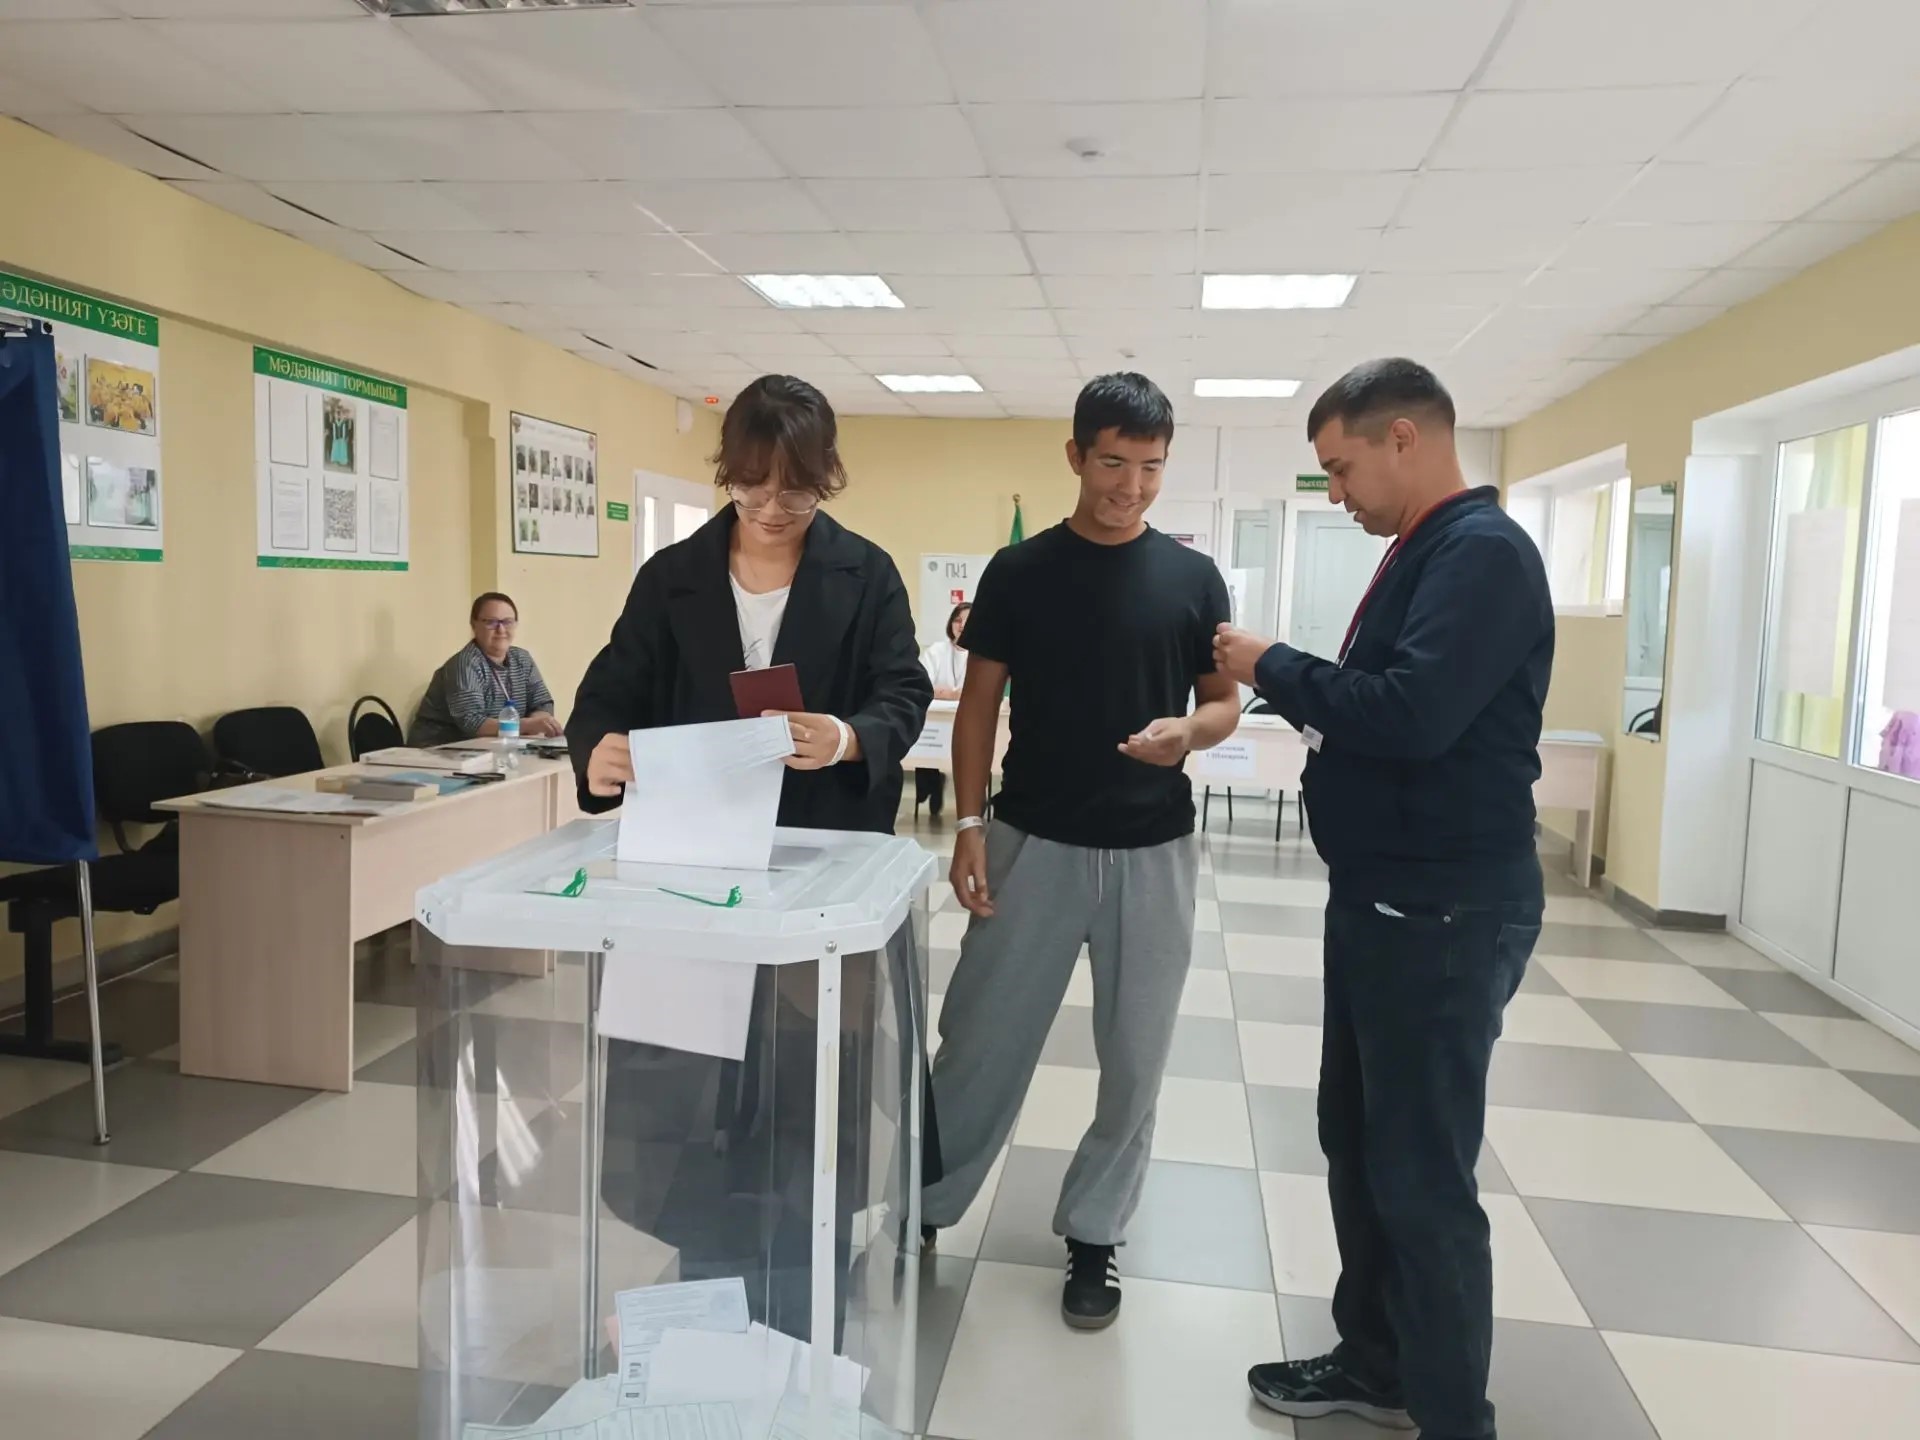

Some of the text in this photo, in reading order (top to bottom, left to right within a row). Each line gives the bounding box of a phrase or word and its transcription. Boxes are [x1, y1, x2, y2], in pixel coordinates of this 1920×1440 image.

[0, 281, 147, 336] ӘДӘНИЯТ ҮЗӘГЕ
[269, 355, 339, 386] МӘДӘНИЯТ
